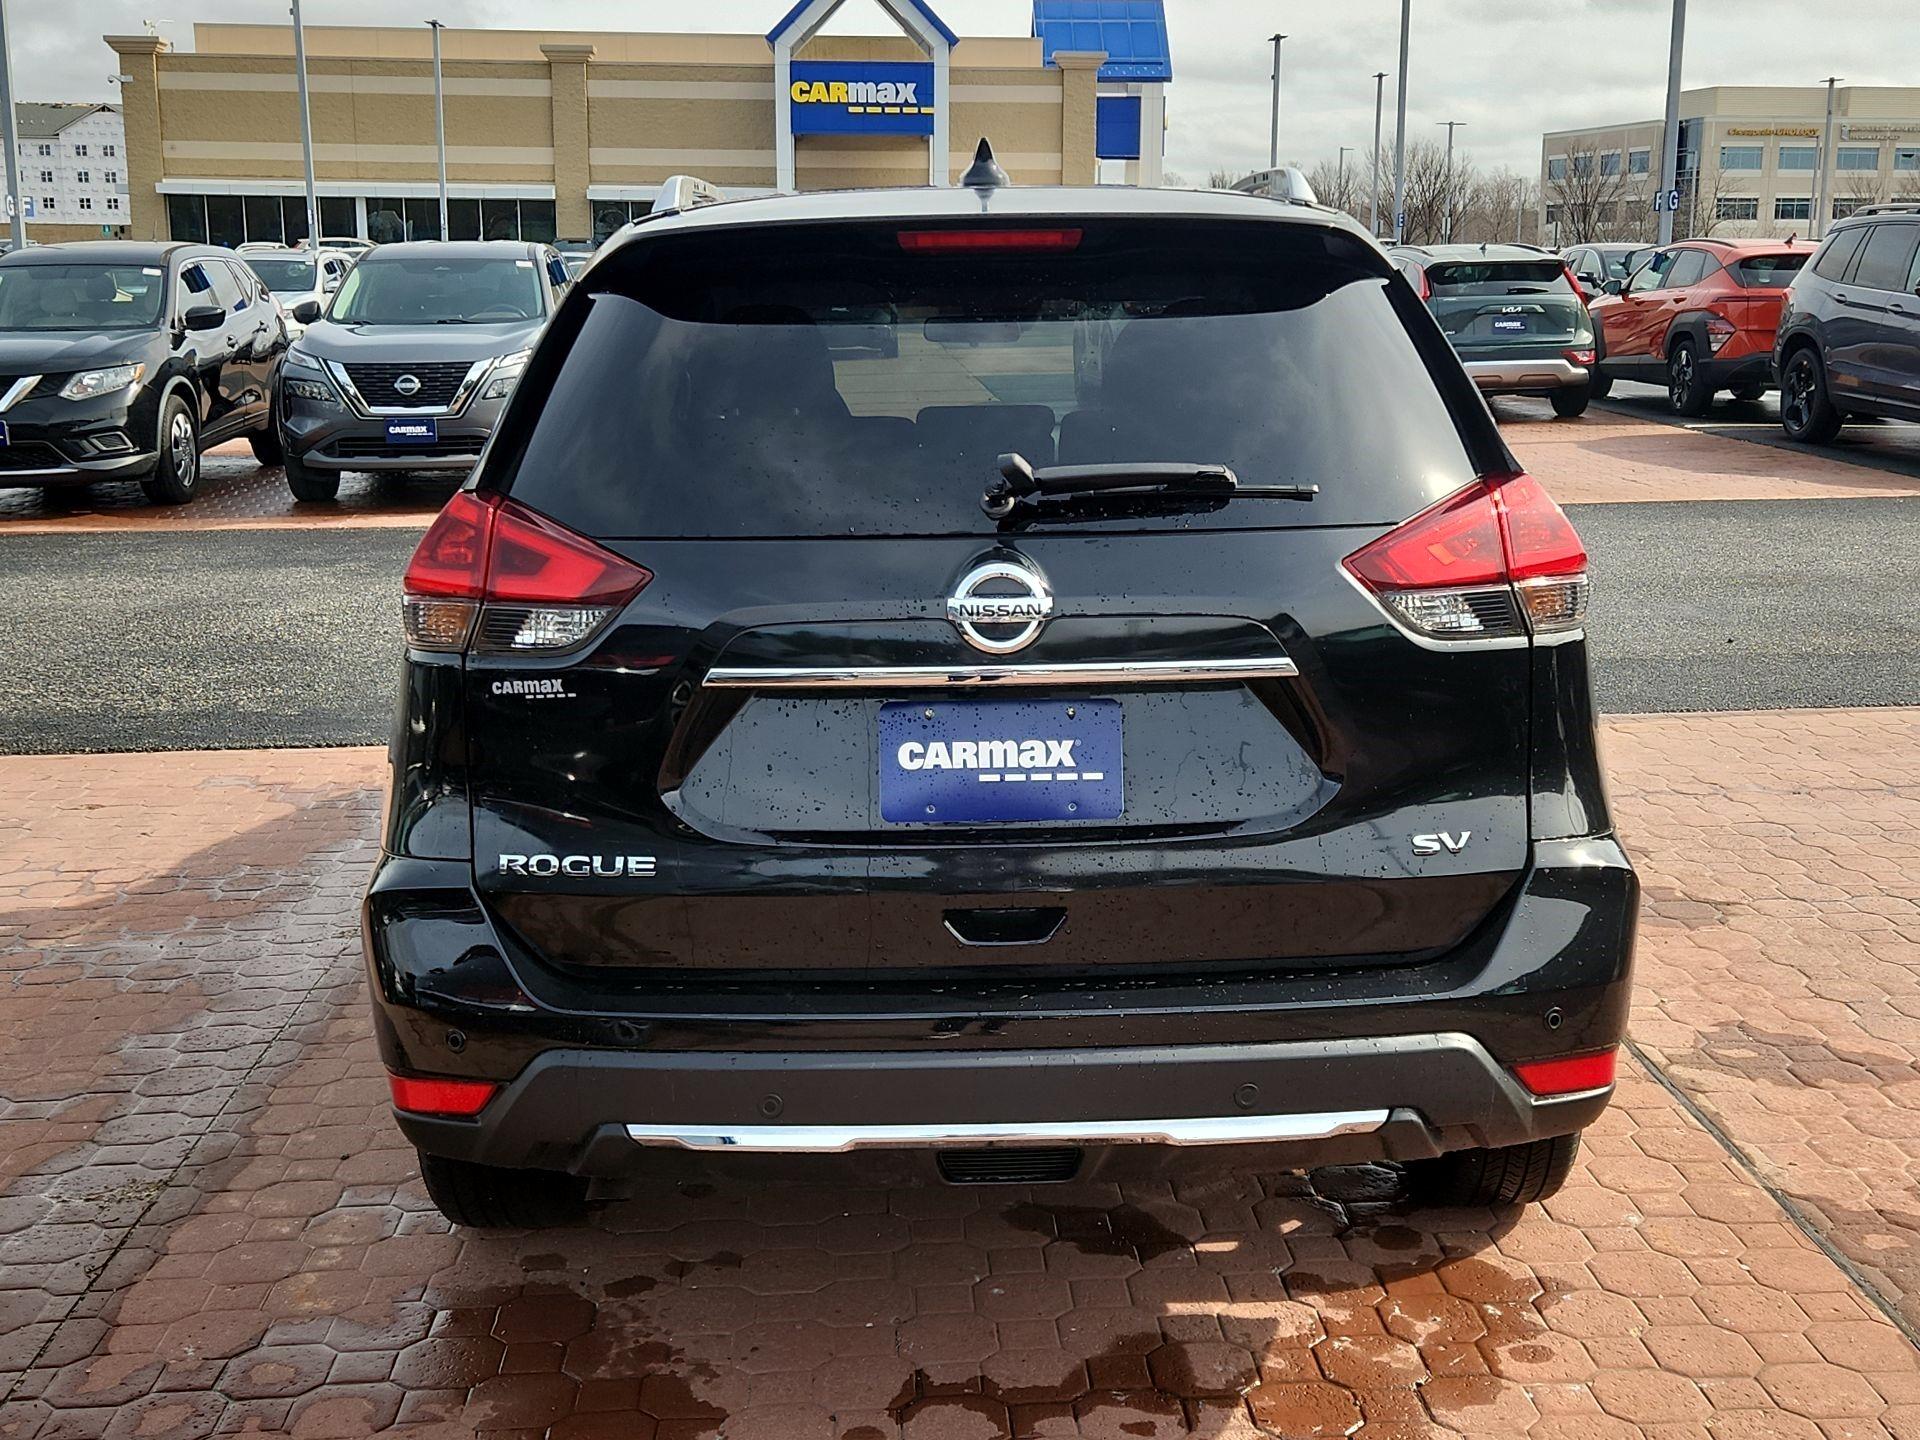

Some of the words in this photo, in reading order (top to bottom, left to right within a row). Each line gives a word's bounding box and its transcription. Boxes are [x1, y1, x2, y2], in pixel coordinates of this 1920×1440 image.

[791, 81, 917, 104] CARmax
[6, 195, 15, 217] G
[22, 196, 32, 216] F
[1669, 190, 1679, 210] G
[1398, 213, 1404, 227] E
[959, 603, 1042, 617] NISSAN
[491, 678, 564, 695] CARmax
[897, 739, 1077, 771] CARmax
[1411, 830, 1472, 857] SV
[498, 853, 657, 878] ROGUE
